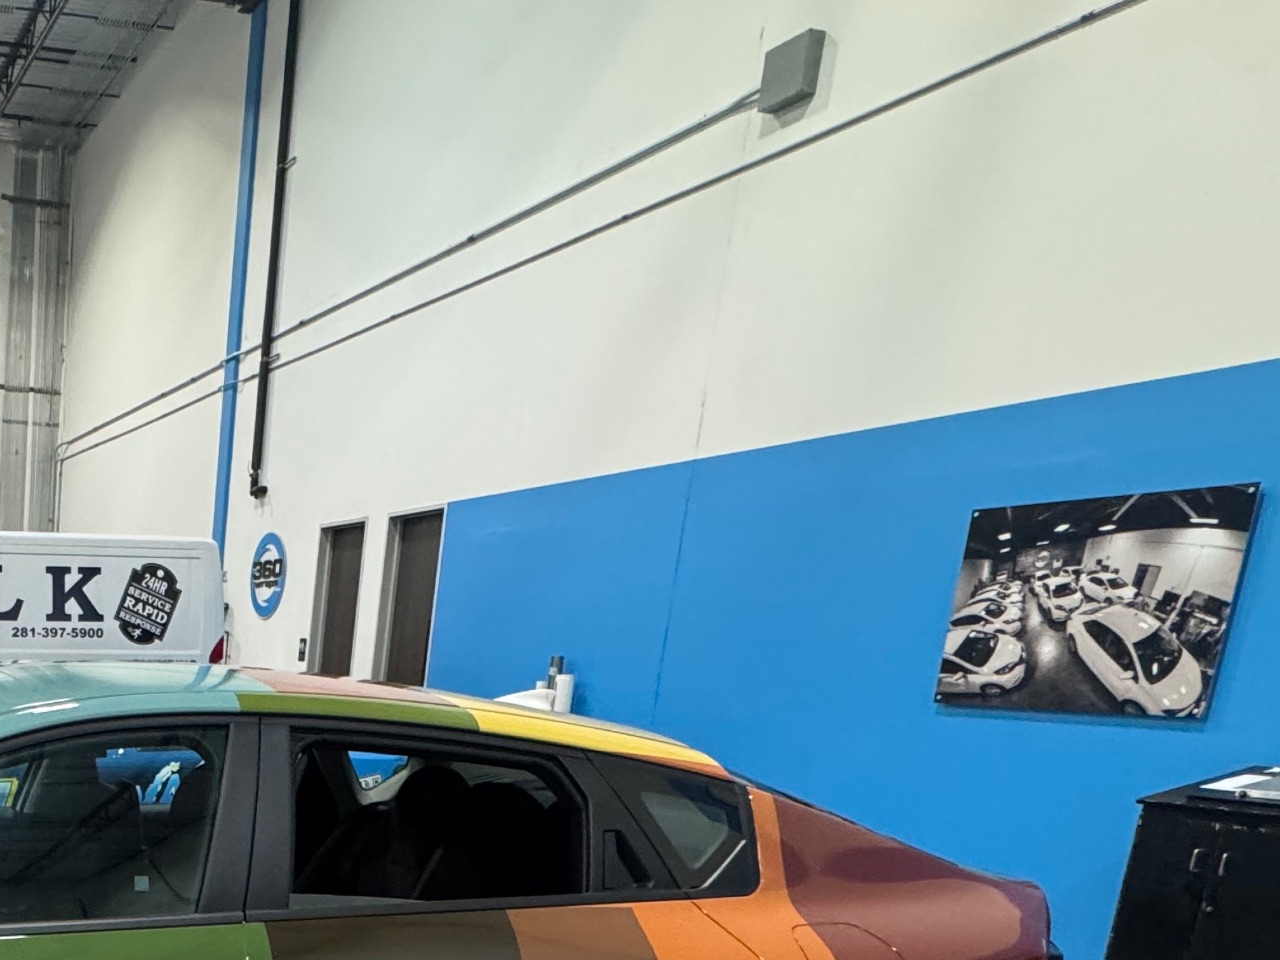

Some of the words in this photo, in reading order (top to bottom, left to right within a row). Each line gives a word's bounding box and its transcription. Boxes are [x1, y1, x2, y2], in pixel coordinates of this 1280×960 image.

[252, 559, 282, 580] 360
[141, 573, 168, 595] 24HR
[123, 596, 167, 624] RAPID
[127, 586, 172, 612] SERVICE
[11, 627, 104, 638] 281-397-5900
[119, 610, 162, 636] RESPONSE
